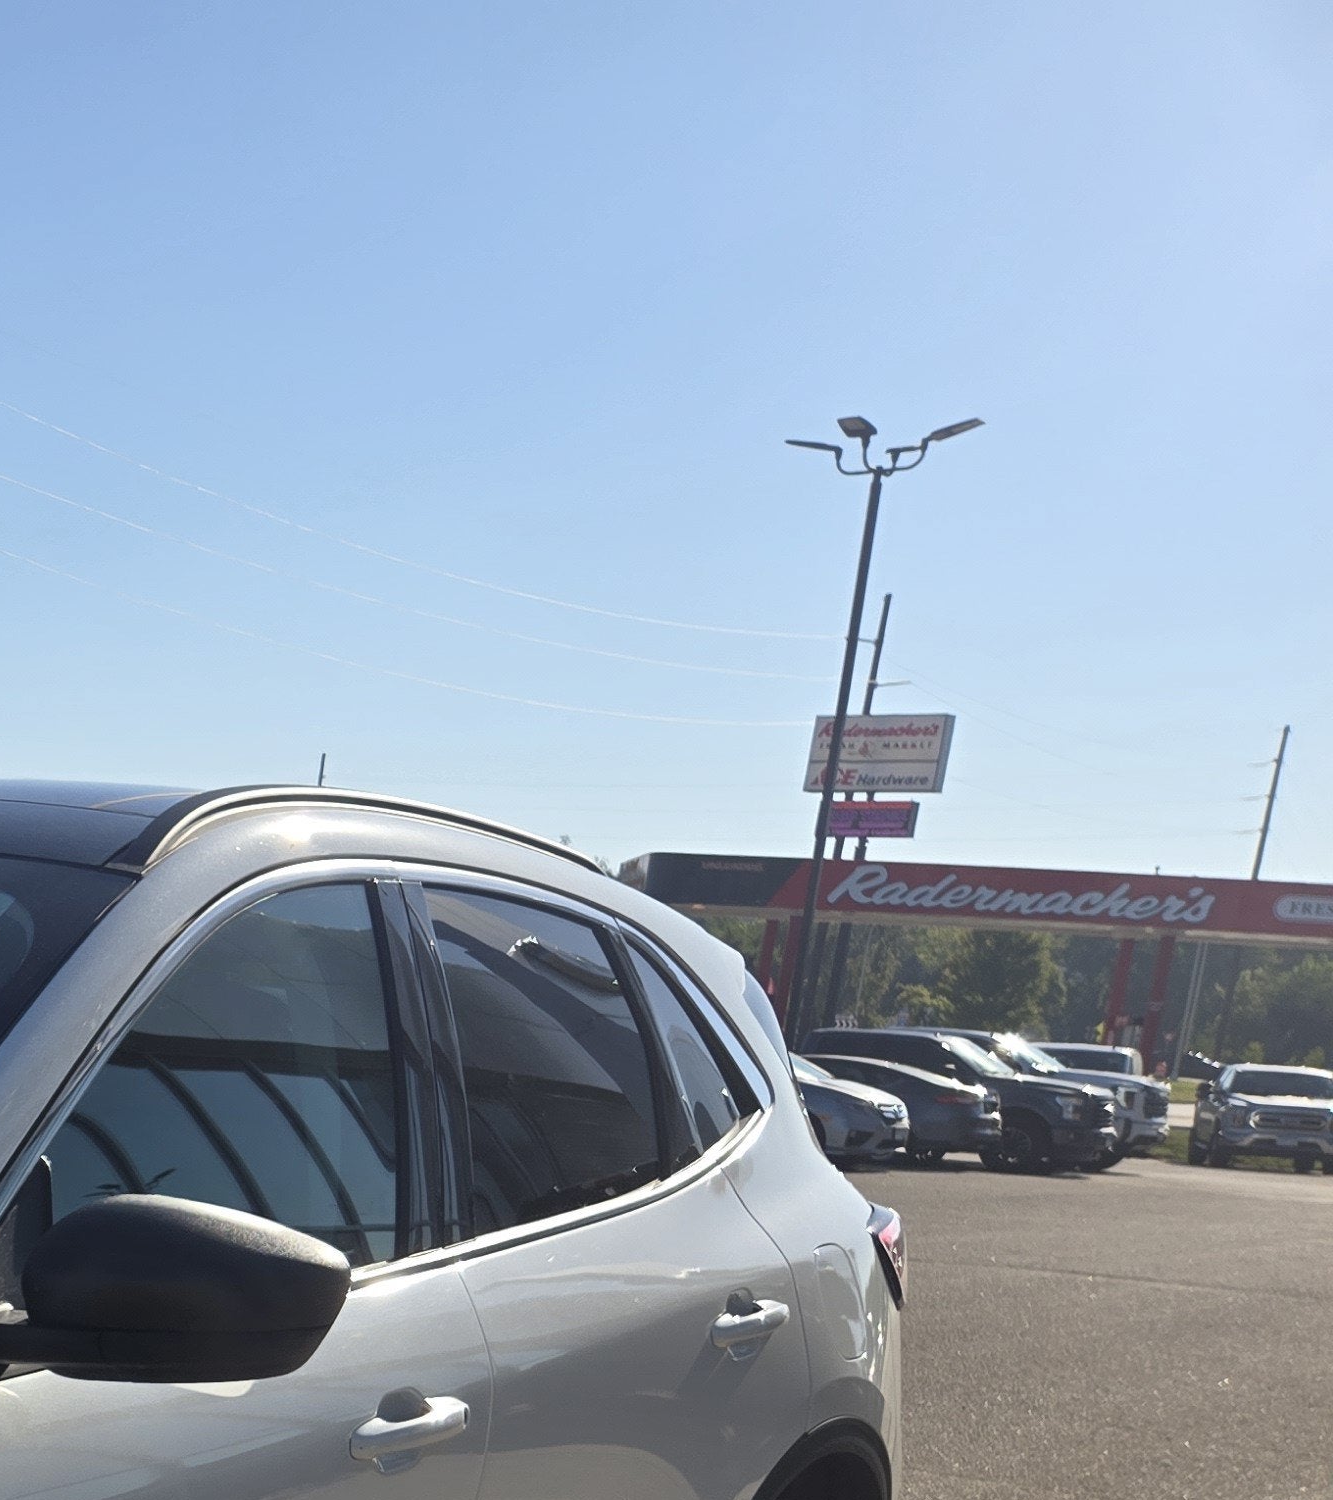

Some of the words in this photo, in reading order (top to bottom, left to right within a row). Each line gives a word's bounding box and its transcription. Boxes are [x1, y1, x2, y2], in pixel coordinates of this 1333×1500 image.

[818, 722, 939, 738] Rdermacher's
[856, 773, 929, 786] Hardware
[828, 864, 1216, 922] Radermacher's
